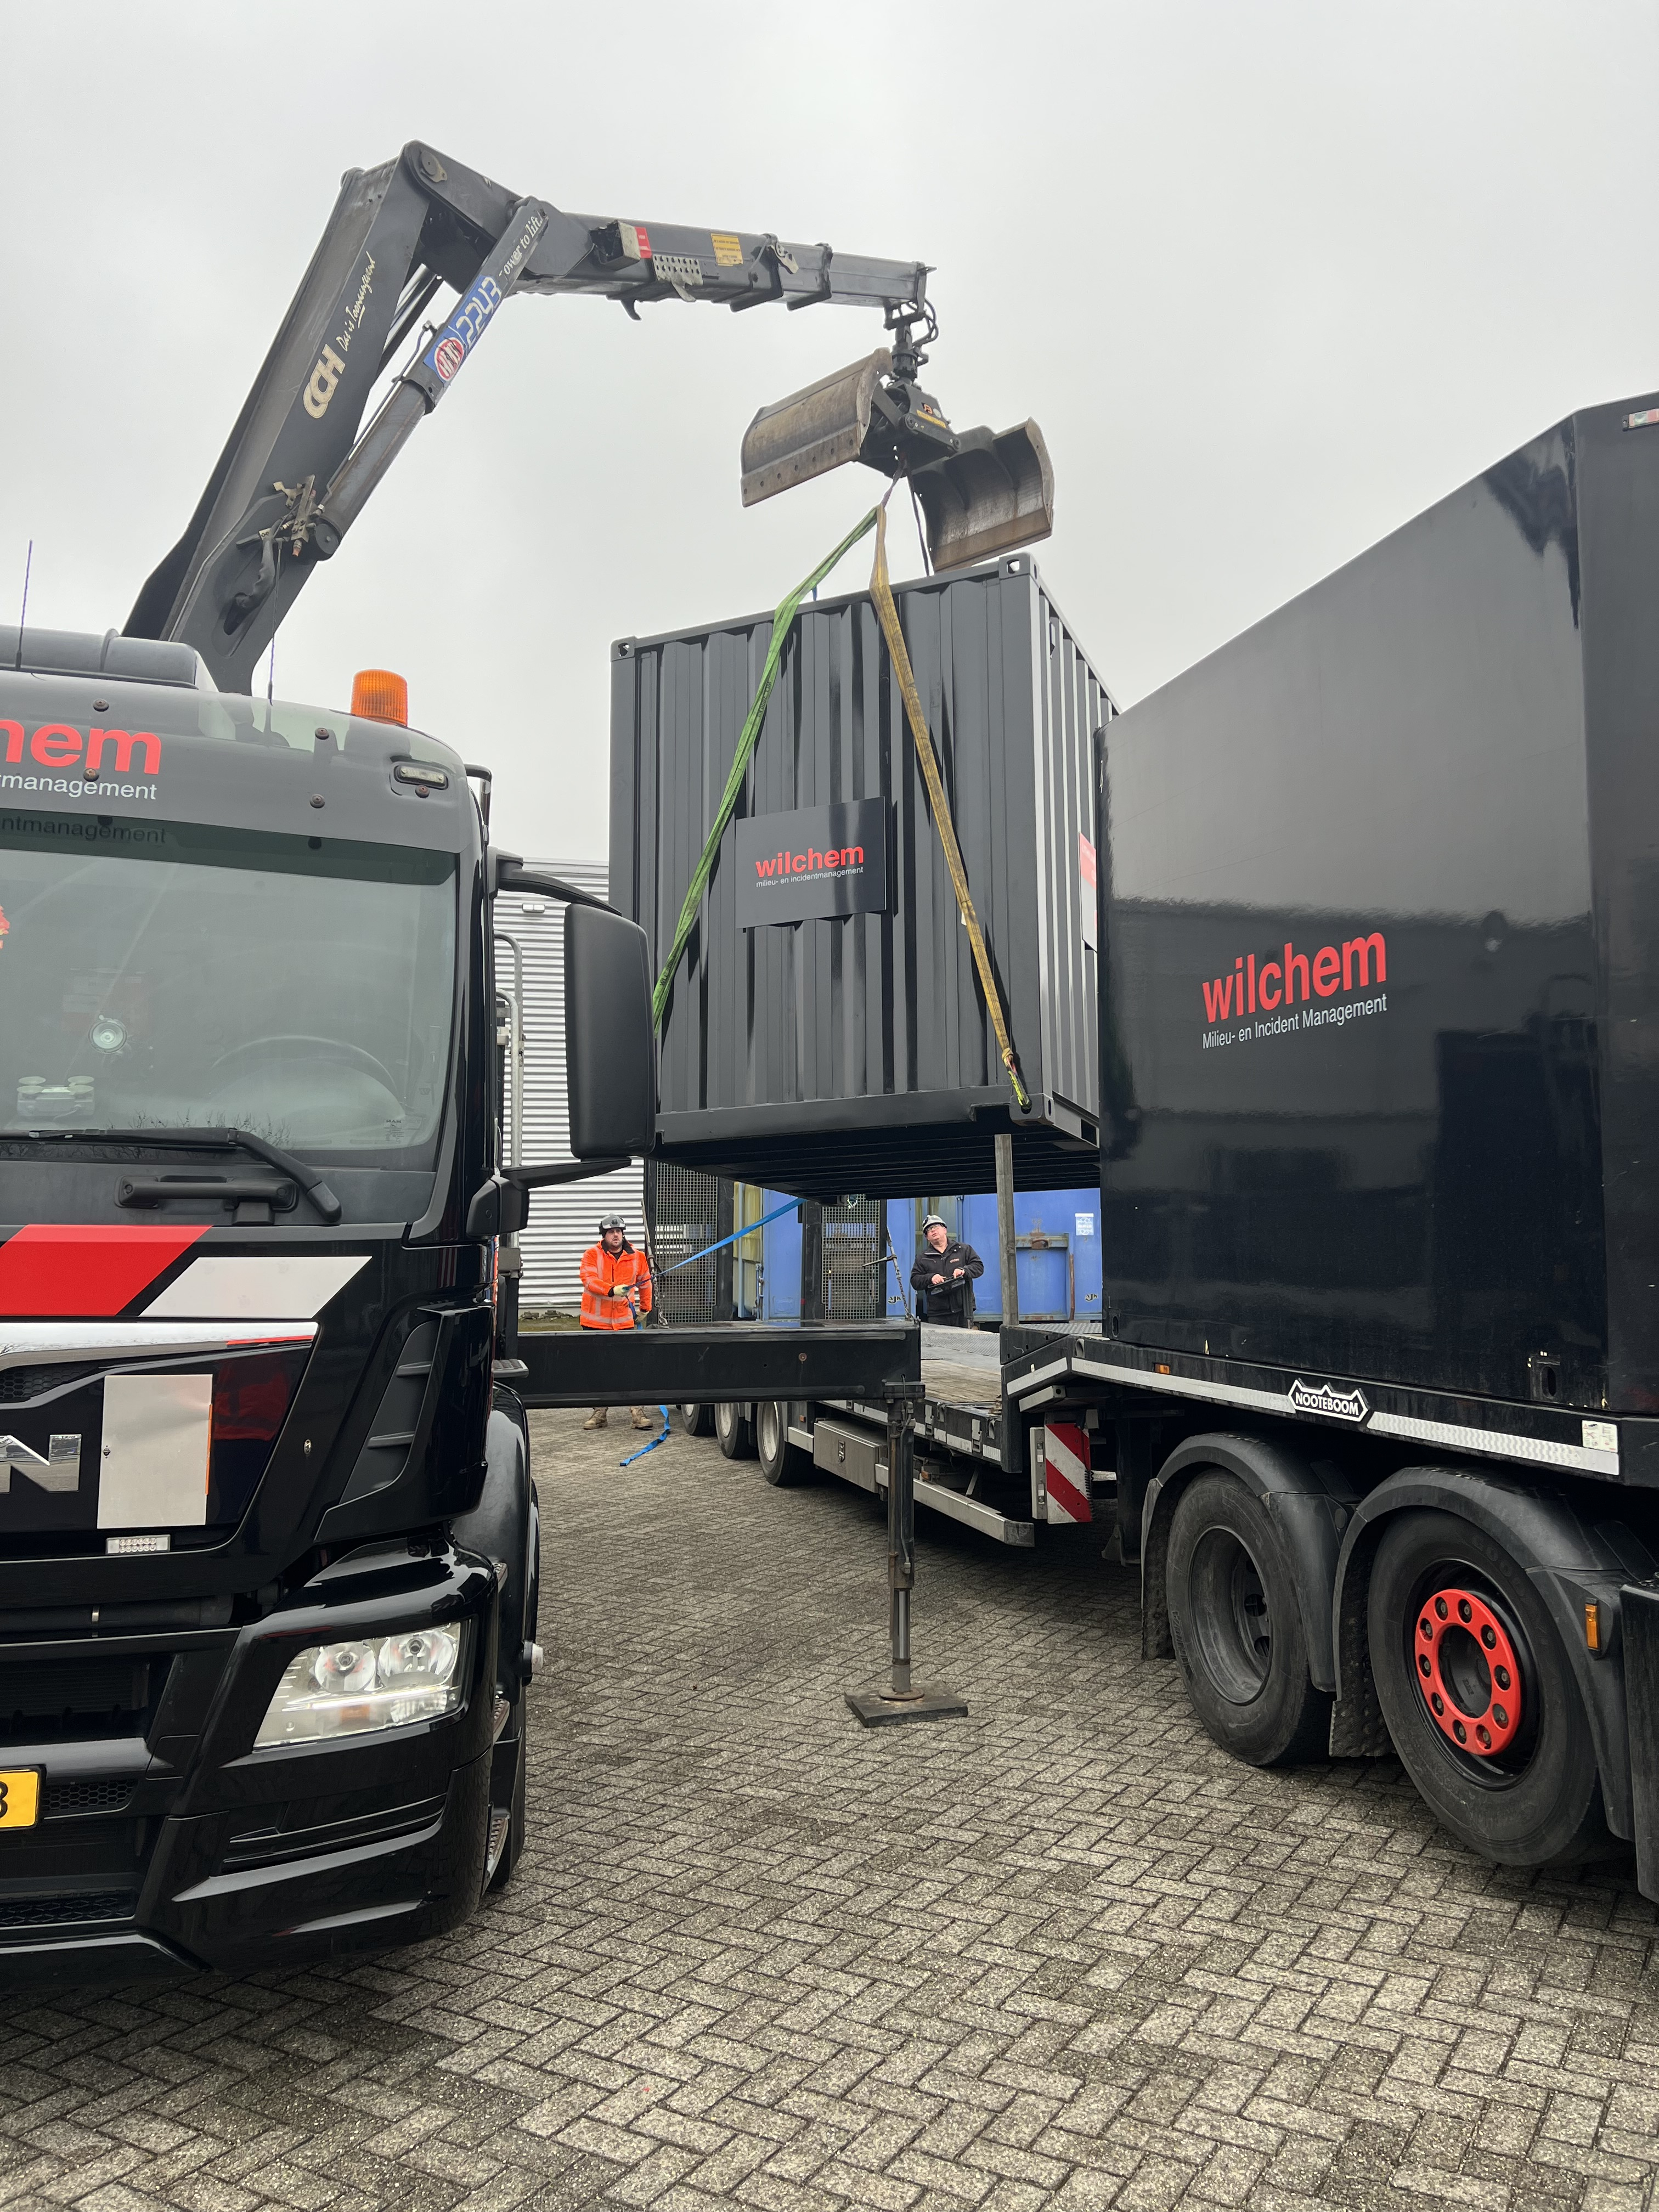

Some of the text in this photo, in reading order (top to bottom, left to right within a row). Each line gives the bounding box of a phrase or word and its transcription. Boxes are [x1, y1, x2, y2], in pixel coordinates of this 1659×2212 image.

[499, 245, 522, 276] ower
[521, 233, 531, 249] to
[344, 320, 355, 332] is
[455, 276, 503, 348] 2243
[0, 774, 157, 799] management
[755, 846, 864, 878] wilchem
[756, 879, 778, 888] milieu-
[791, 866, 864, 882] incidentmanagement
[1202, 932, 1387, 1023] wilchem
[1203, 994, 1387, 1049] Milieu- en Incident Management
[1295, 1392, 1359, 1416] NOOTEBOOM
